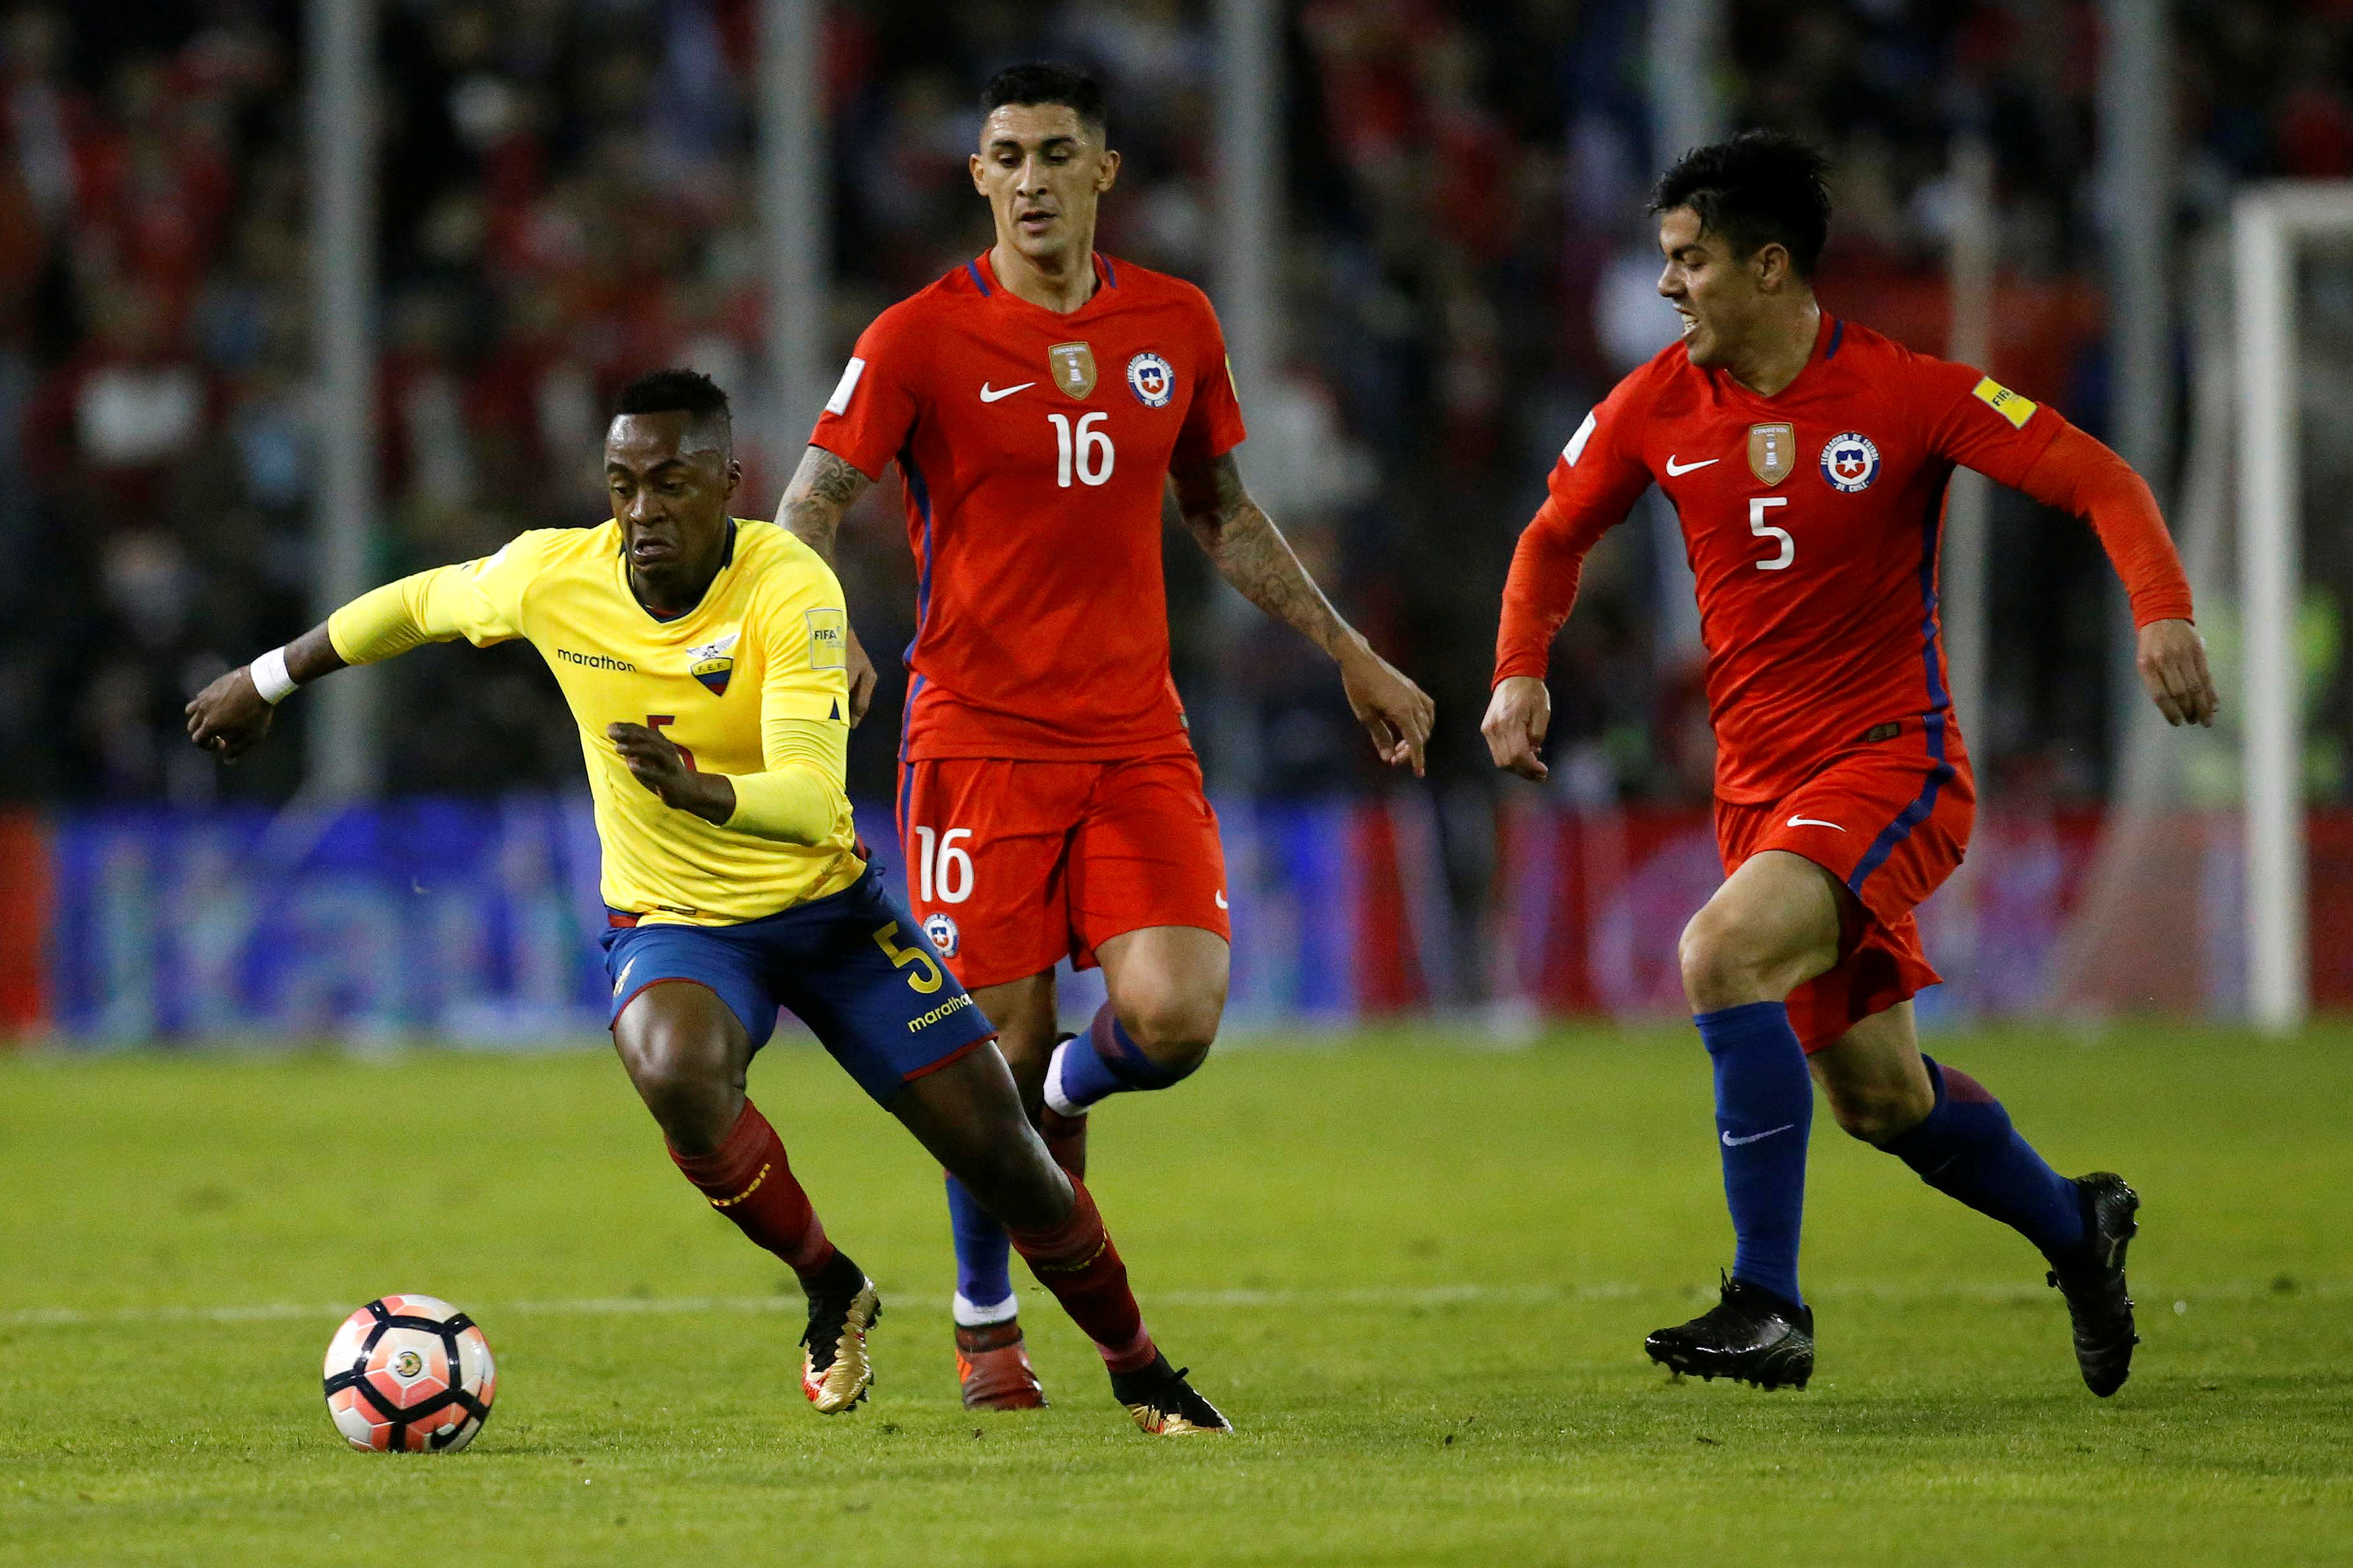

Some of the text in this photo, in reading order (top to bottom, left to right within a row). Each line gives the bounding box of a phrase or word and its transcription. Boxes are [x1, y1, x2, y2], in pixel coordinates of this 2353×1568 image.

[1047, 411, 1115, 488] 16
[1748, 497, 1796, 571] 5
[557, 648, 637, 673] marathon
[813, 629, 837, 641] FIFA
[915, 825, 975, 904] 16
[873, 919, 943, 994] 5
